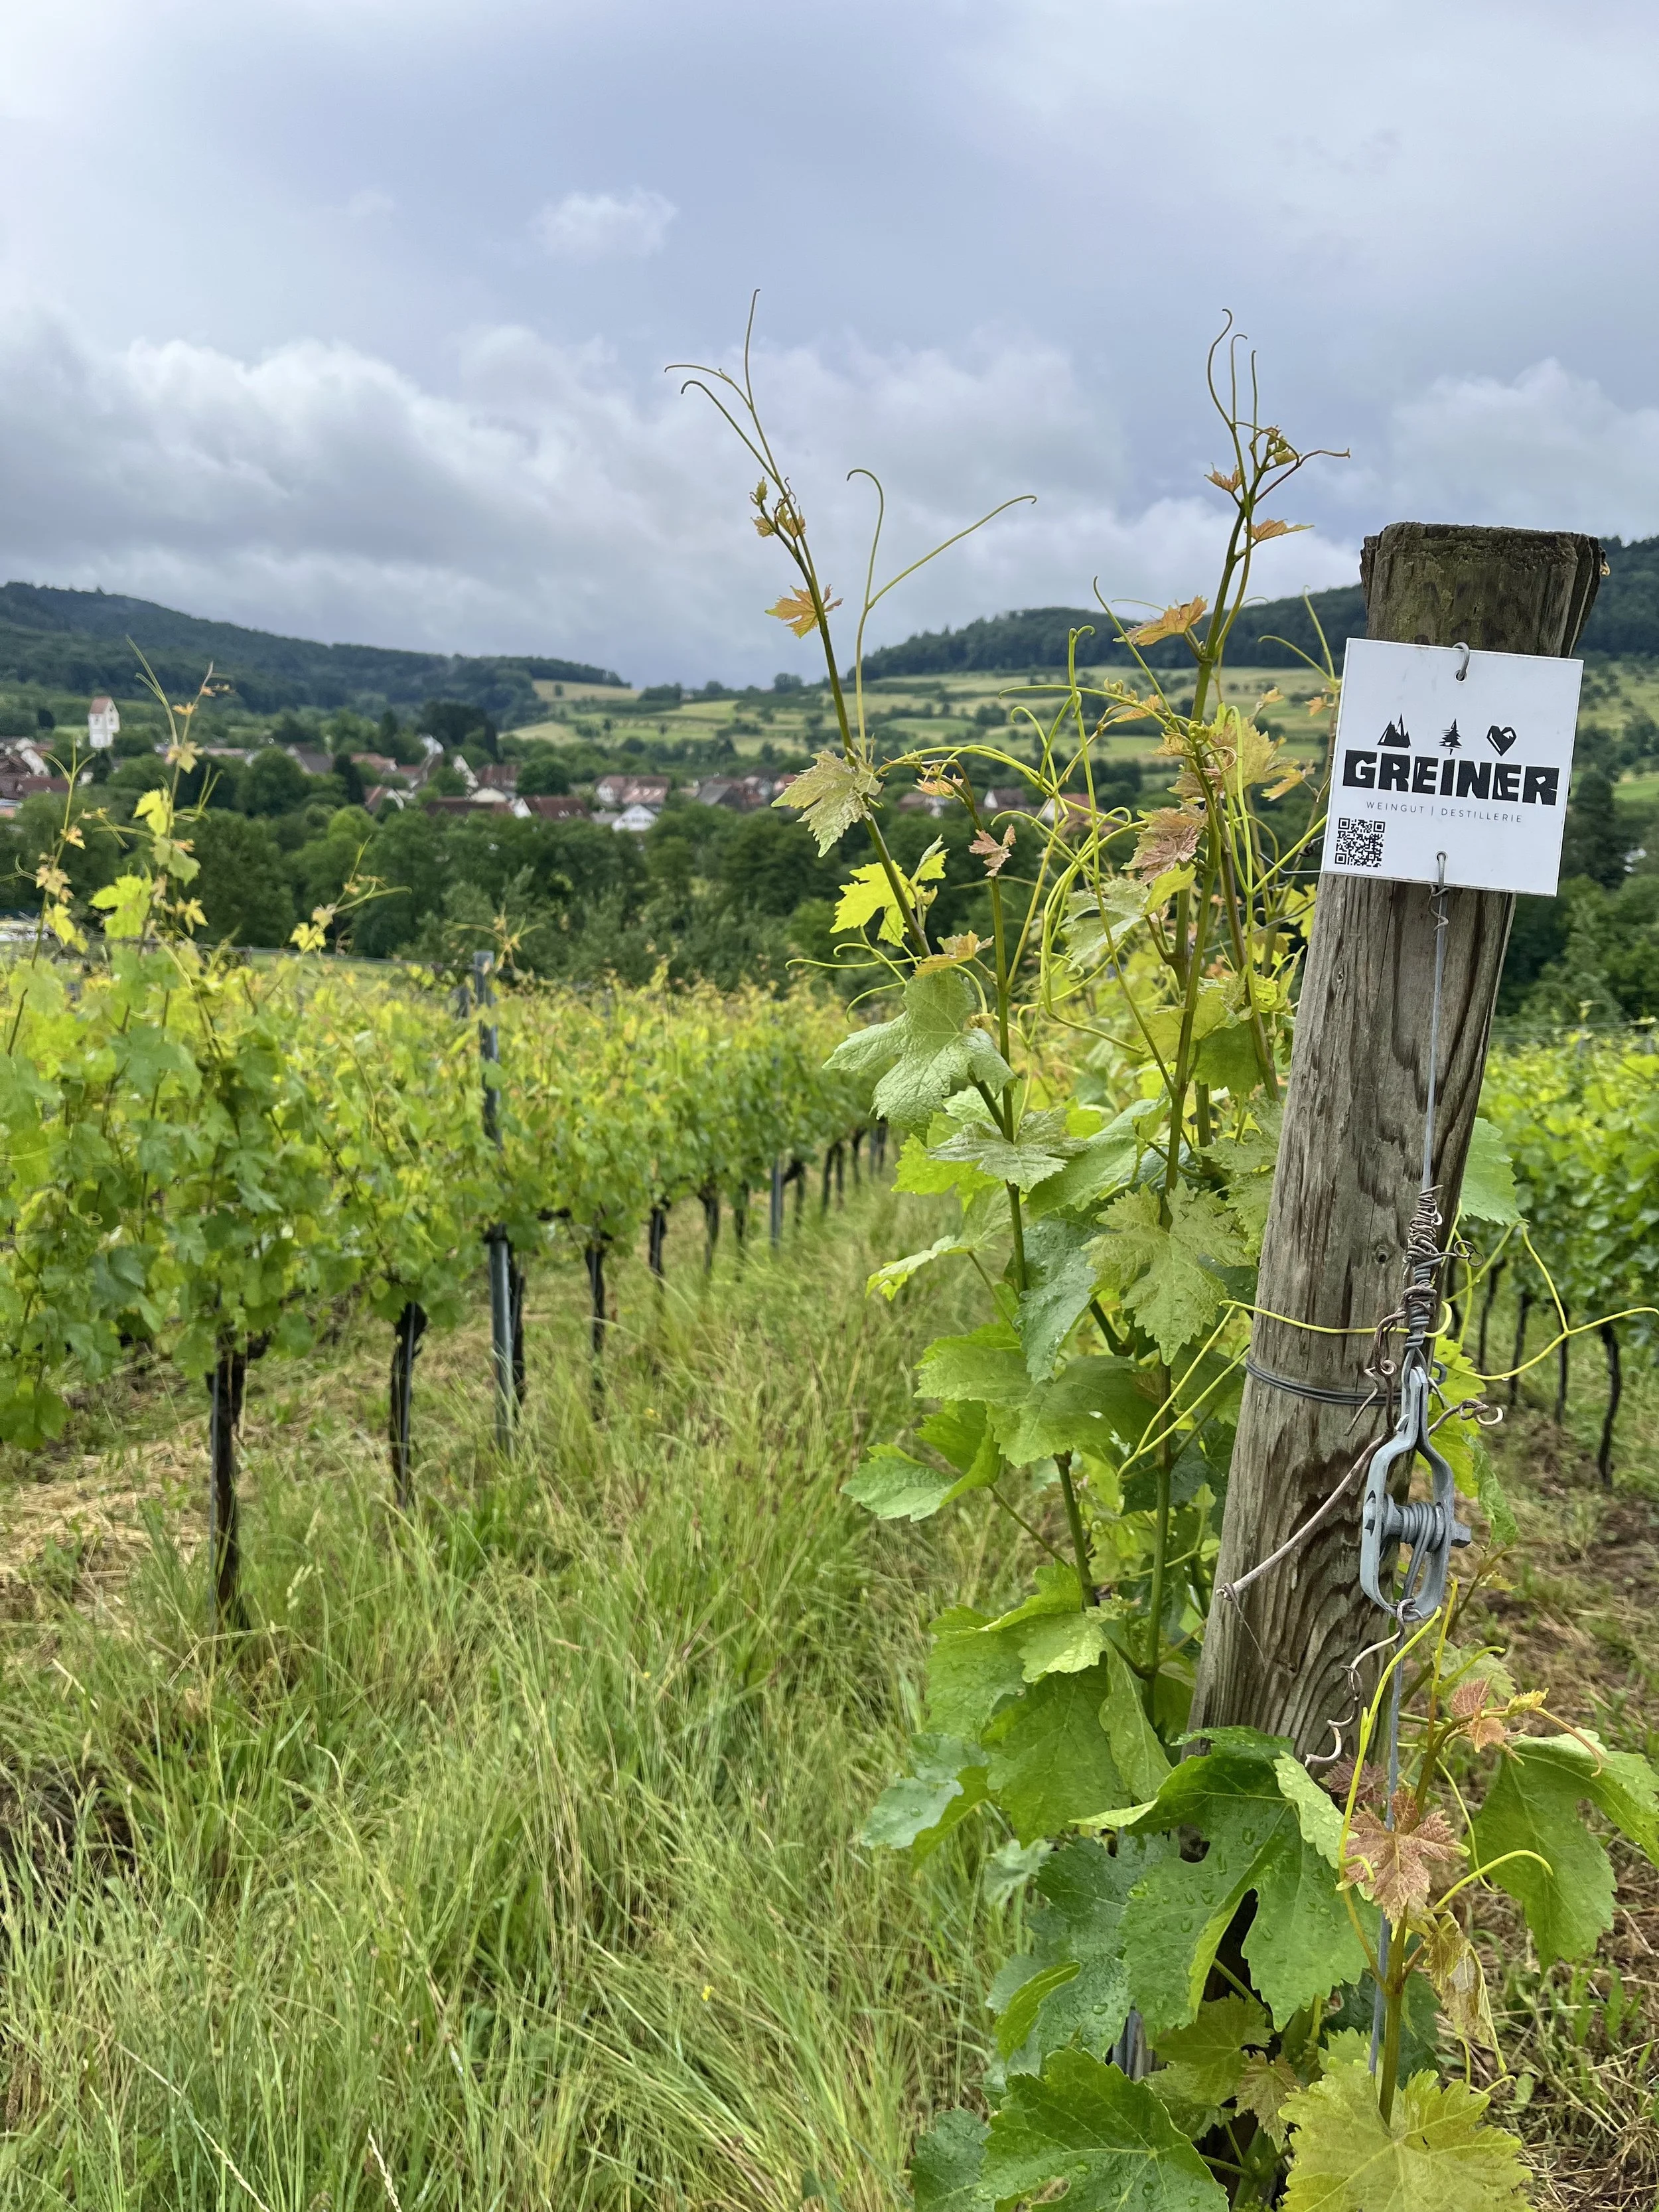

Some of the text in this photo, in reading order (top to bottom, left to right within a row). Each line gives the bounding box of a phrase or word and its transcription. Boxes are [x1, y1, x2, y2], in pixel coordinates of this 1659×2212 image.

[1342, 750, 1559, 806] GREINER
[1366, 801, 1522, 823] WEINGUT DESTILLERIE
